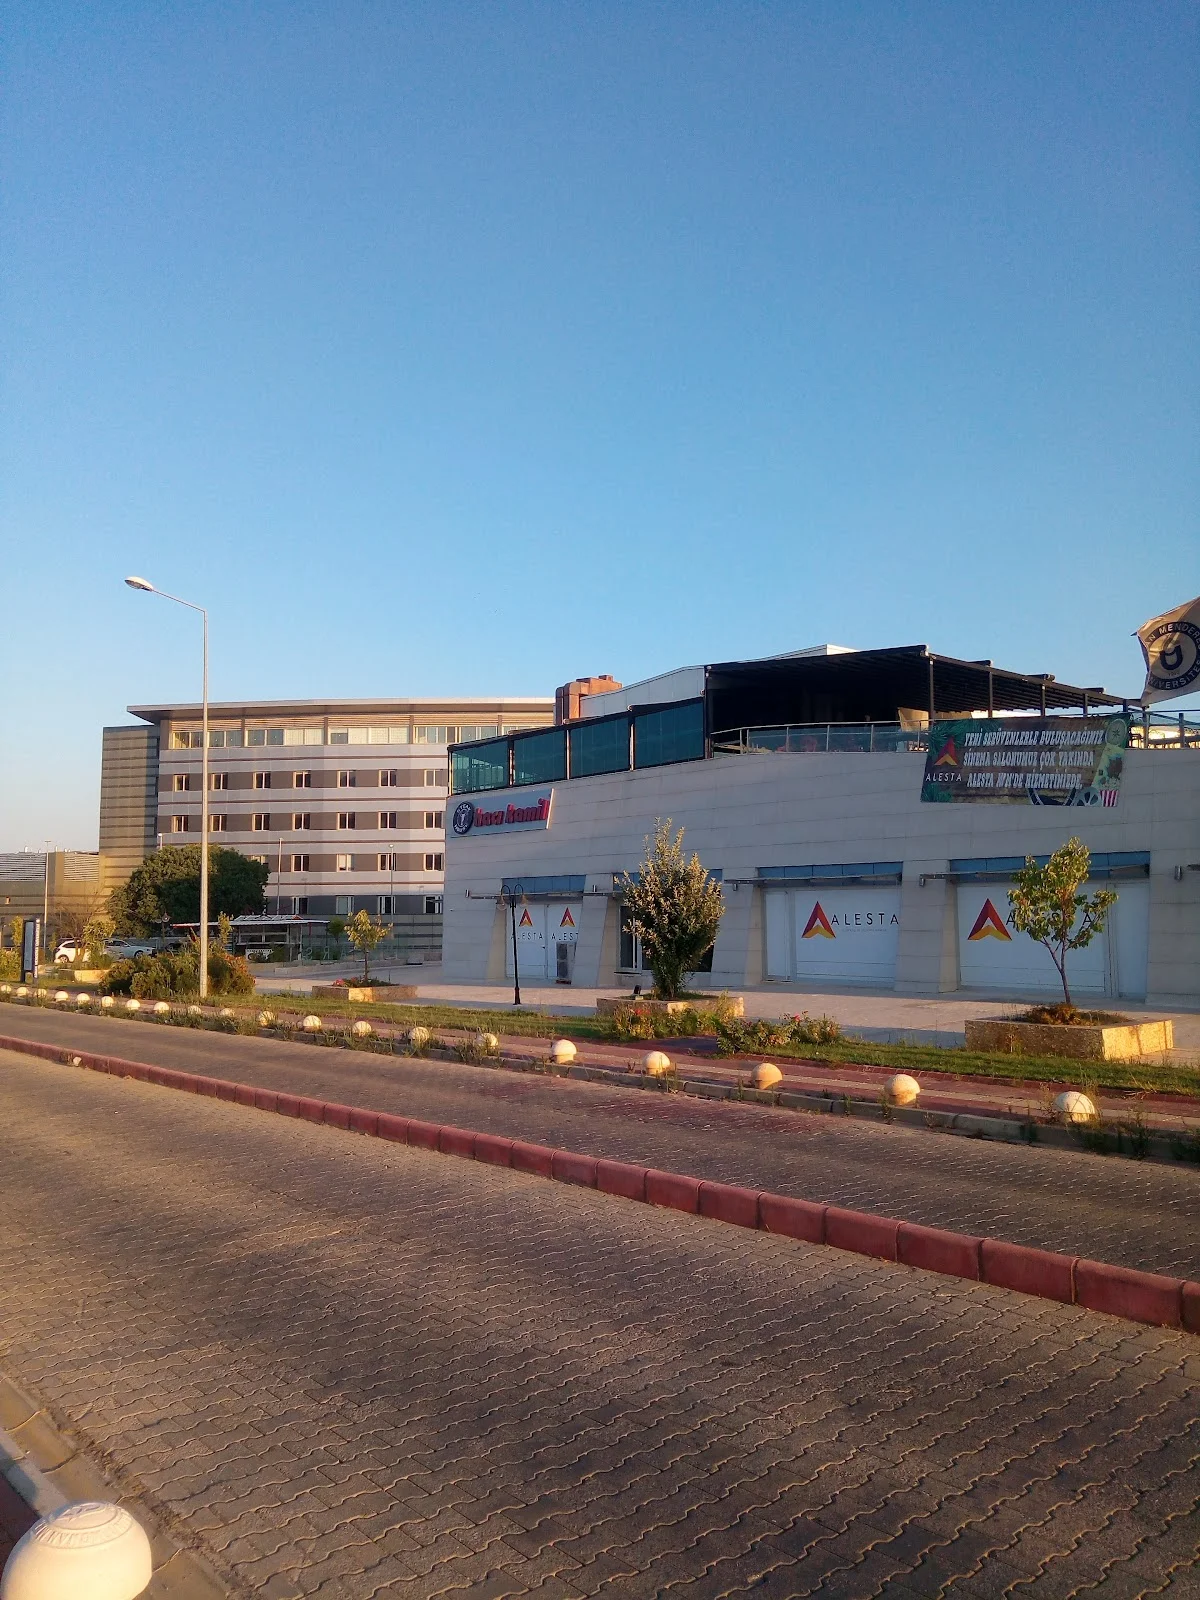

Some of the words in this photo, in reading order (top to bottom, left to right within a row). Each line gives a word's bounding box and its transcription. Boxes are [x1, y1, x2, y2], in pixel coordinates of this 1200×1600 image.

[964, 728, 983, 747] YENİ
[983, 727, 1039, 747] SERÜVENLERLE
[1039, 726, 1105, 750] BULUŞACAĞIMIZ
[963, 748, 991, 767] SİNEMA
[992, 751, 1038, 767] SALONUMUZ
[1039, 751, 1056, 771] ÇOK
[1058, 751, 1094, 767] YAKINDA
[925, 772, 962, 782] ALESTA
[966, 772, 994, 788] ALESTA
[830, 912, 899, 926] ALESTA
[551, 932, 580, 941] ALEST
